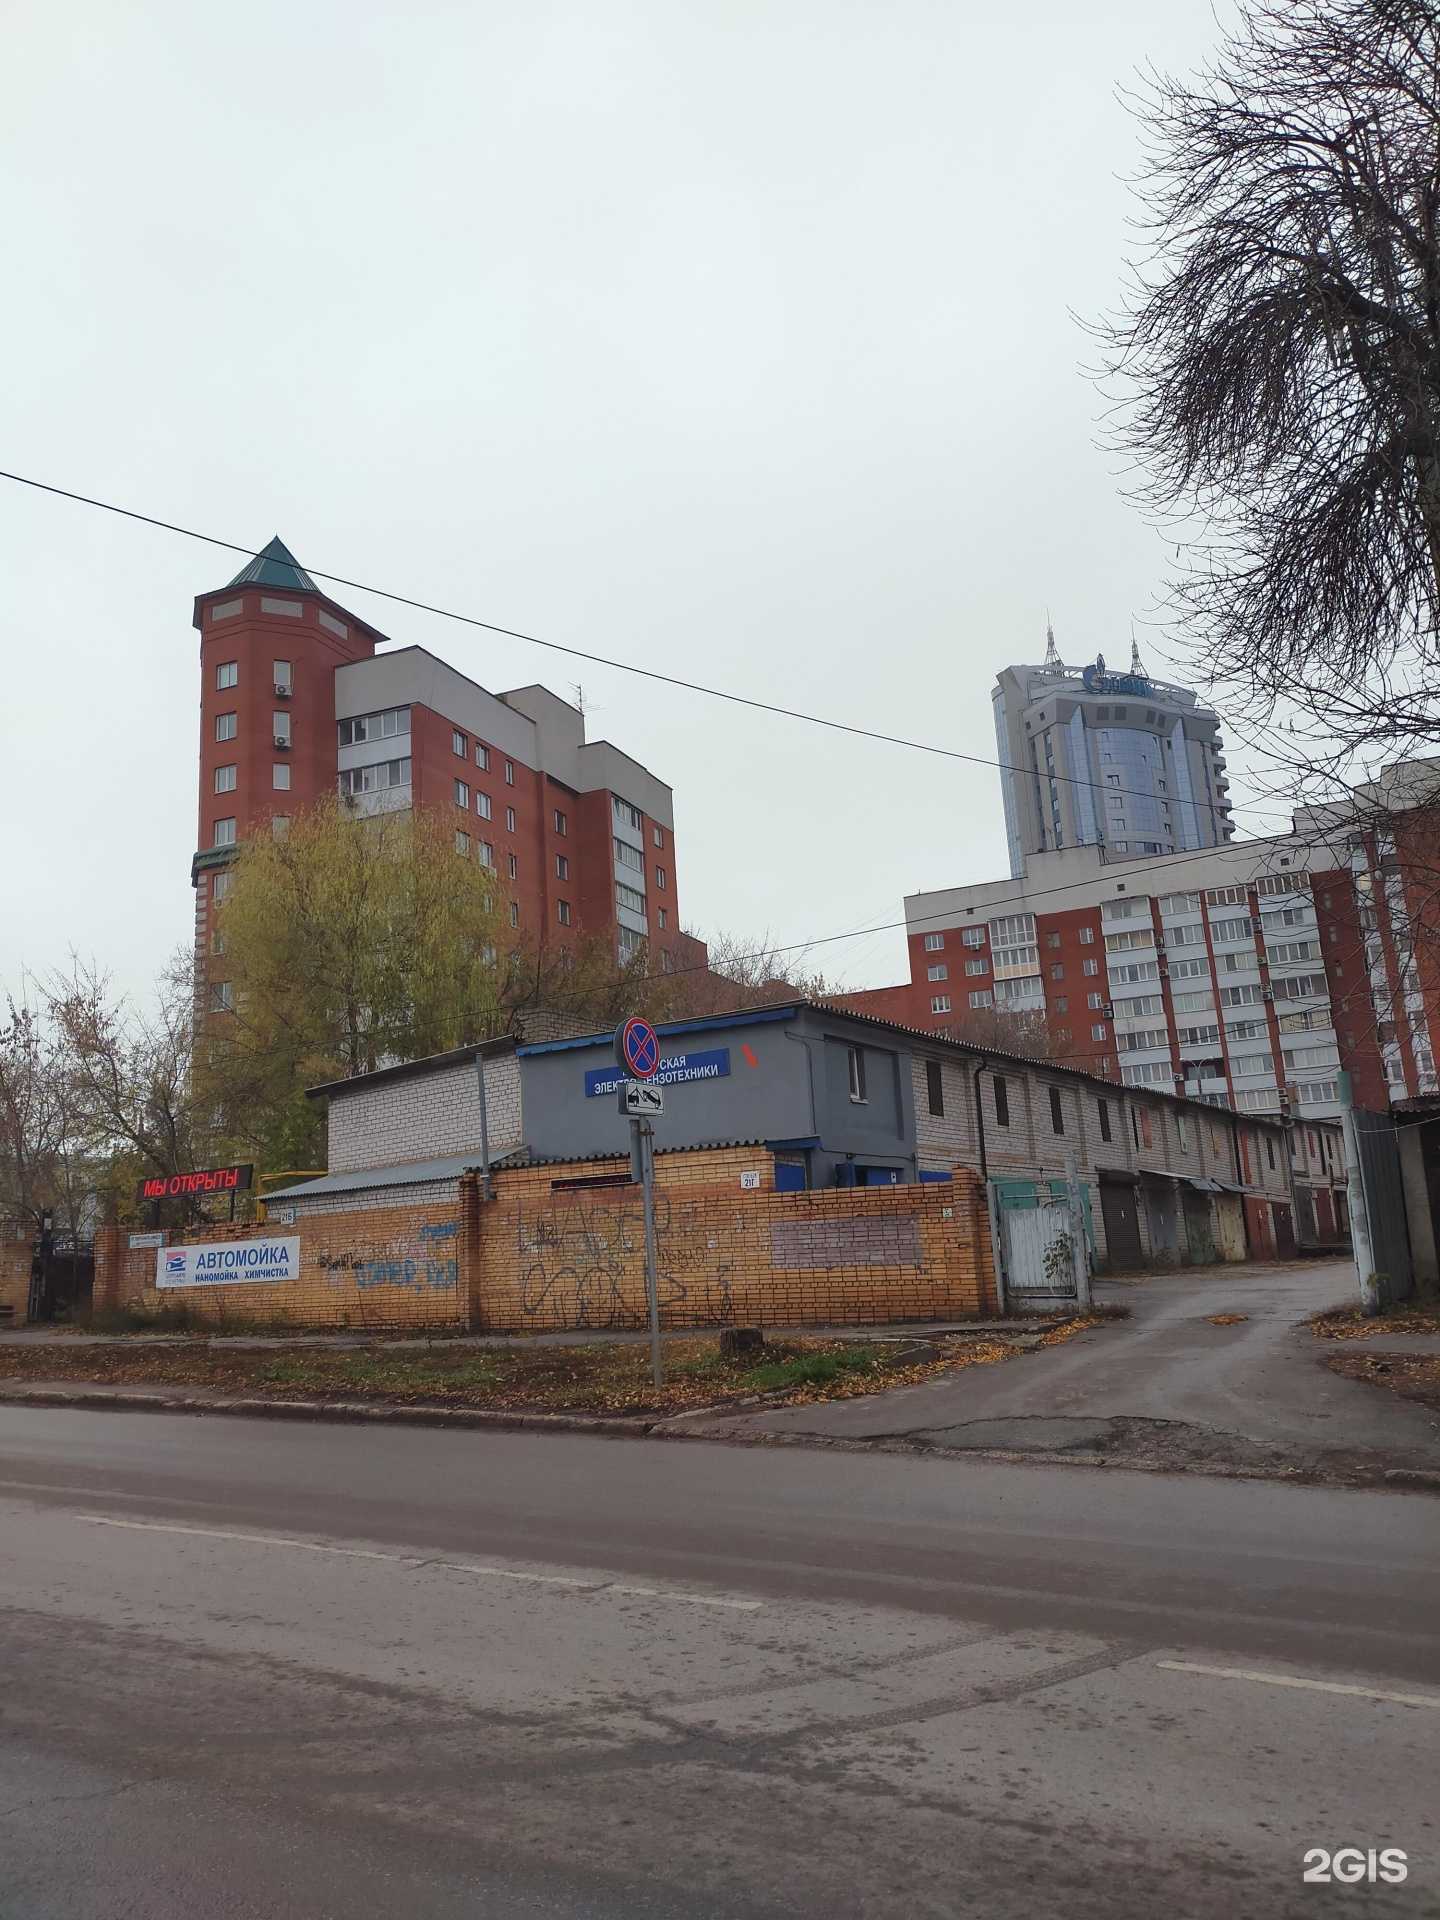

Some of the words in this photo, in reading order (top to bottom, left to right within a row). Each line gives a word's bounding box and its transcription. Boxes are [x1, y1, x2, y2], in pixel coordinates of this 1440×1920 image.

[143, 1179, 167, 1198] МЫ
[169, 1168, 239, 1195] ОТКРЫТЫ
[196, 1243, 290, 1270] АВТОМОЙКА
[195, 1269, 238, 1283] НАНОМОЙКА
[244, 1267, 289, 1280] ХИМЧИСТКА
